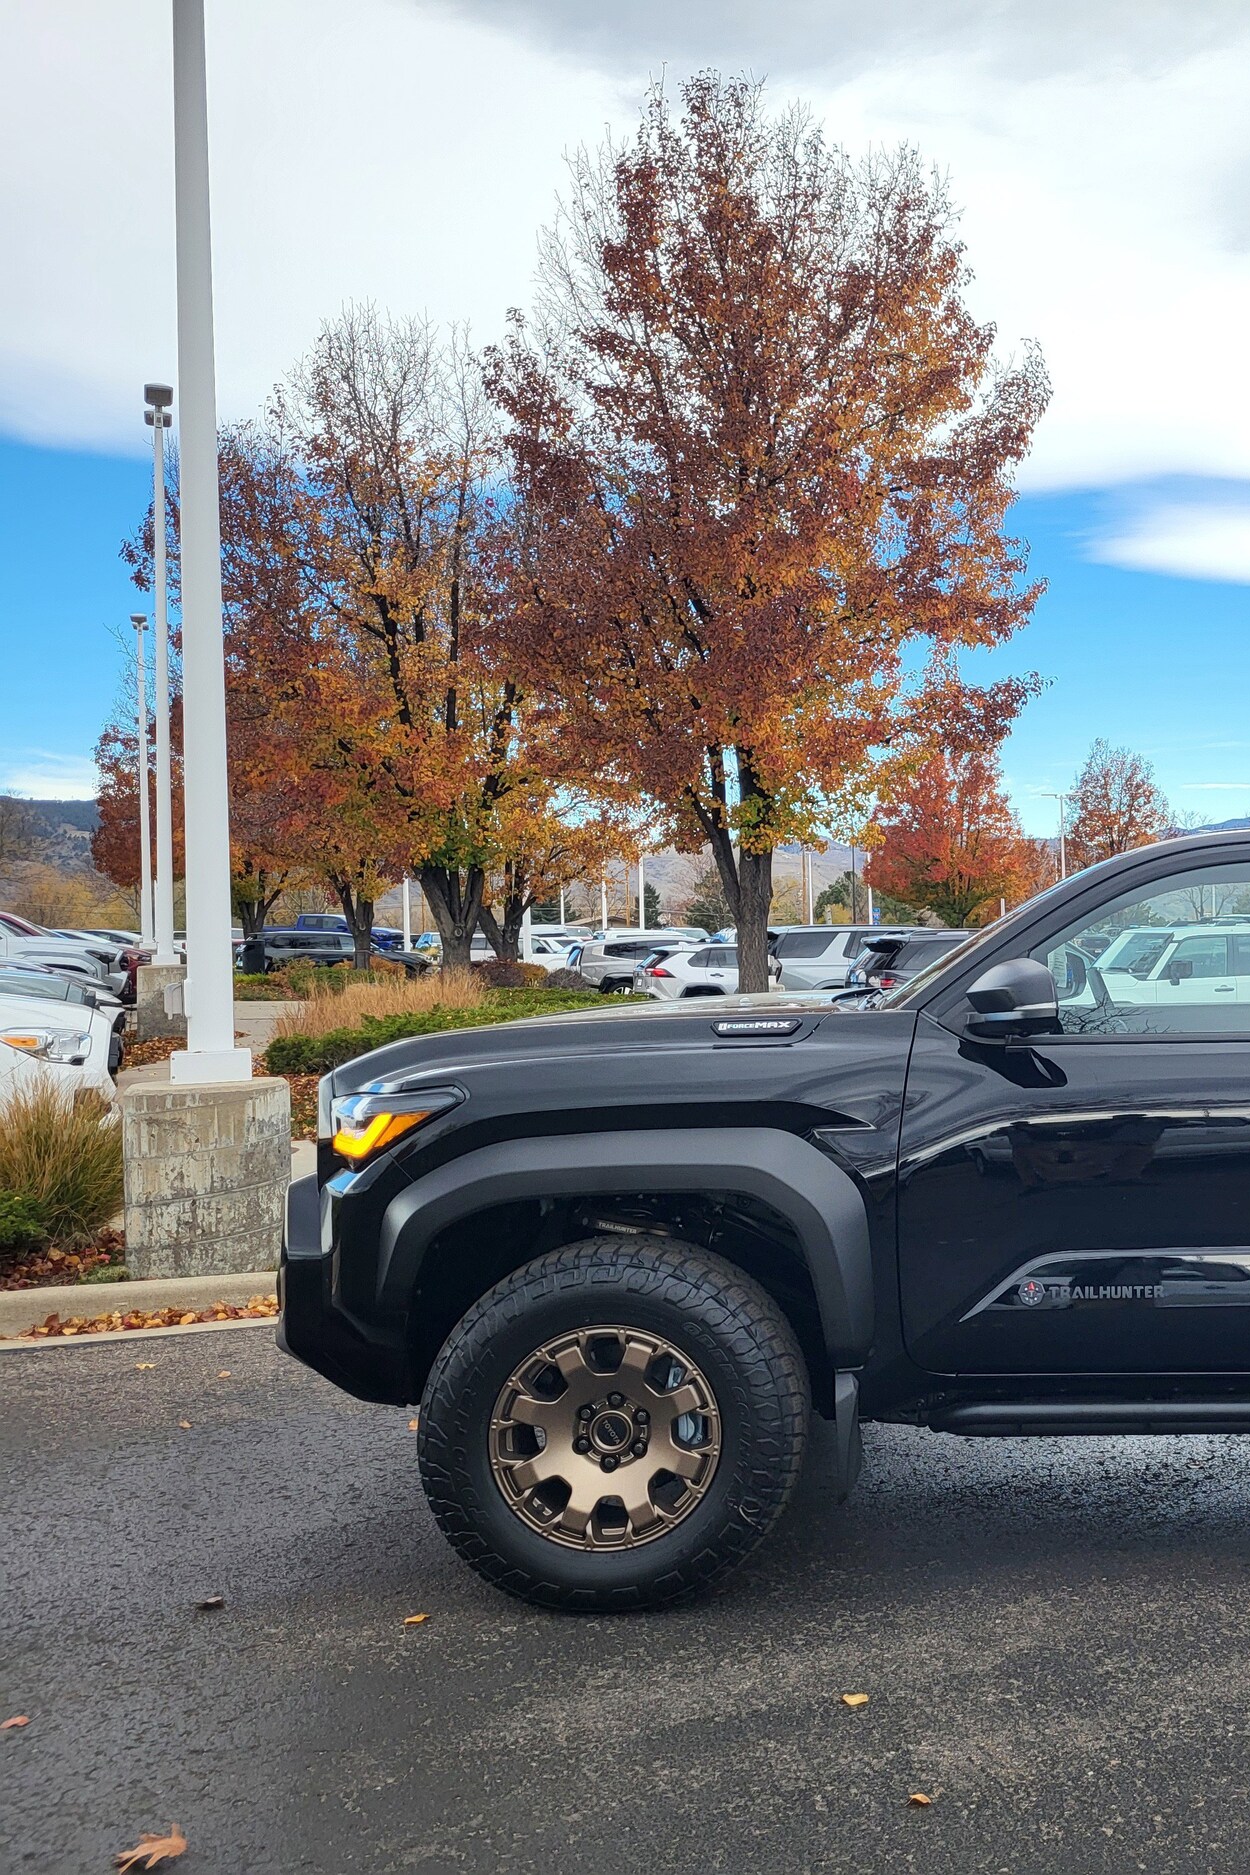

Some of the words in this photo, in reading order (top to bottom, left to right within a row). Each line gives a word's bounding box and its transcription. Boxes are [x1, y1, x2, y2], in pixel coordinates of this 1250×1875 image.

[598, 1221, 637, 1234] TRAILHUNTER
[1049, 1285, 1165, 1299] TRAILHUNTER
[602, 1420, 620, 1444] TOYOTA
